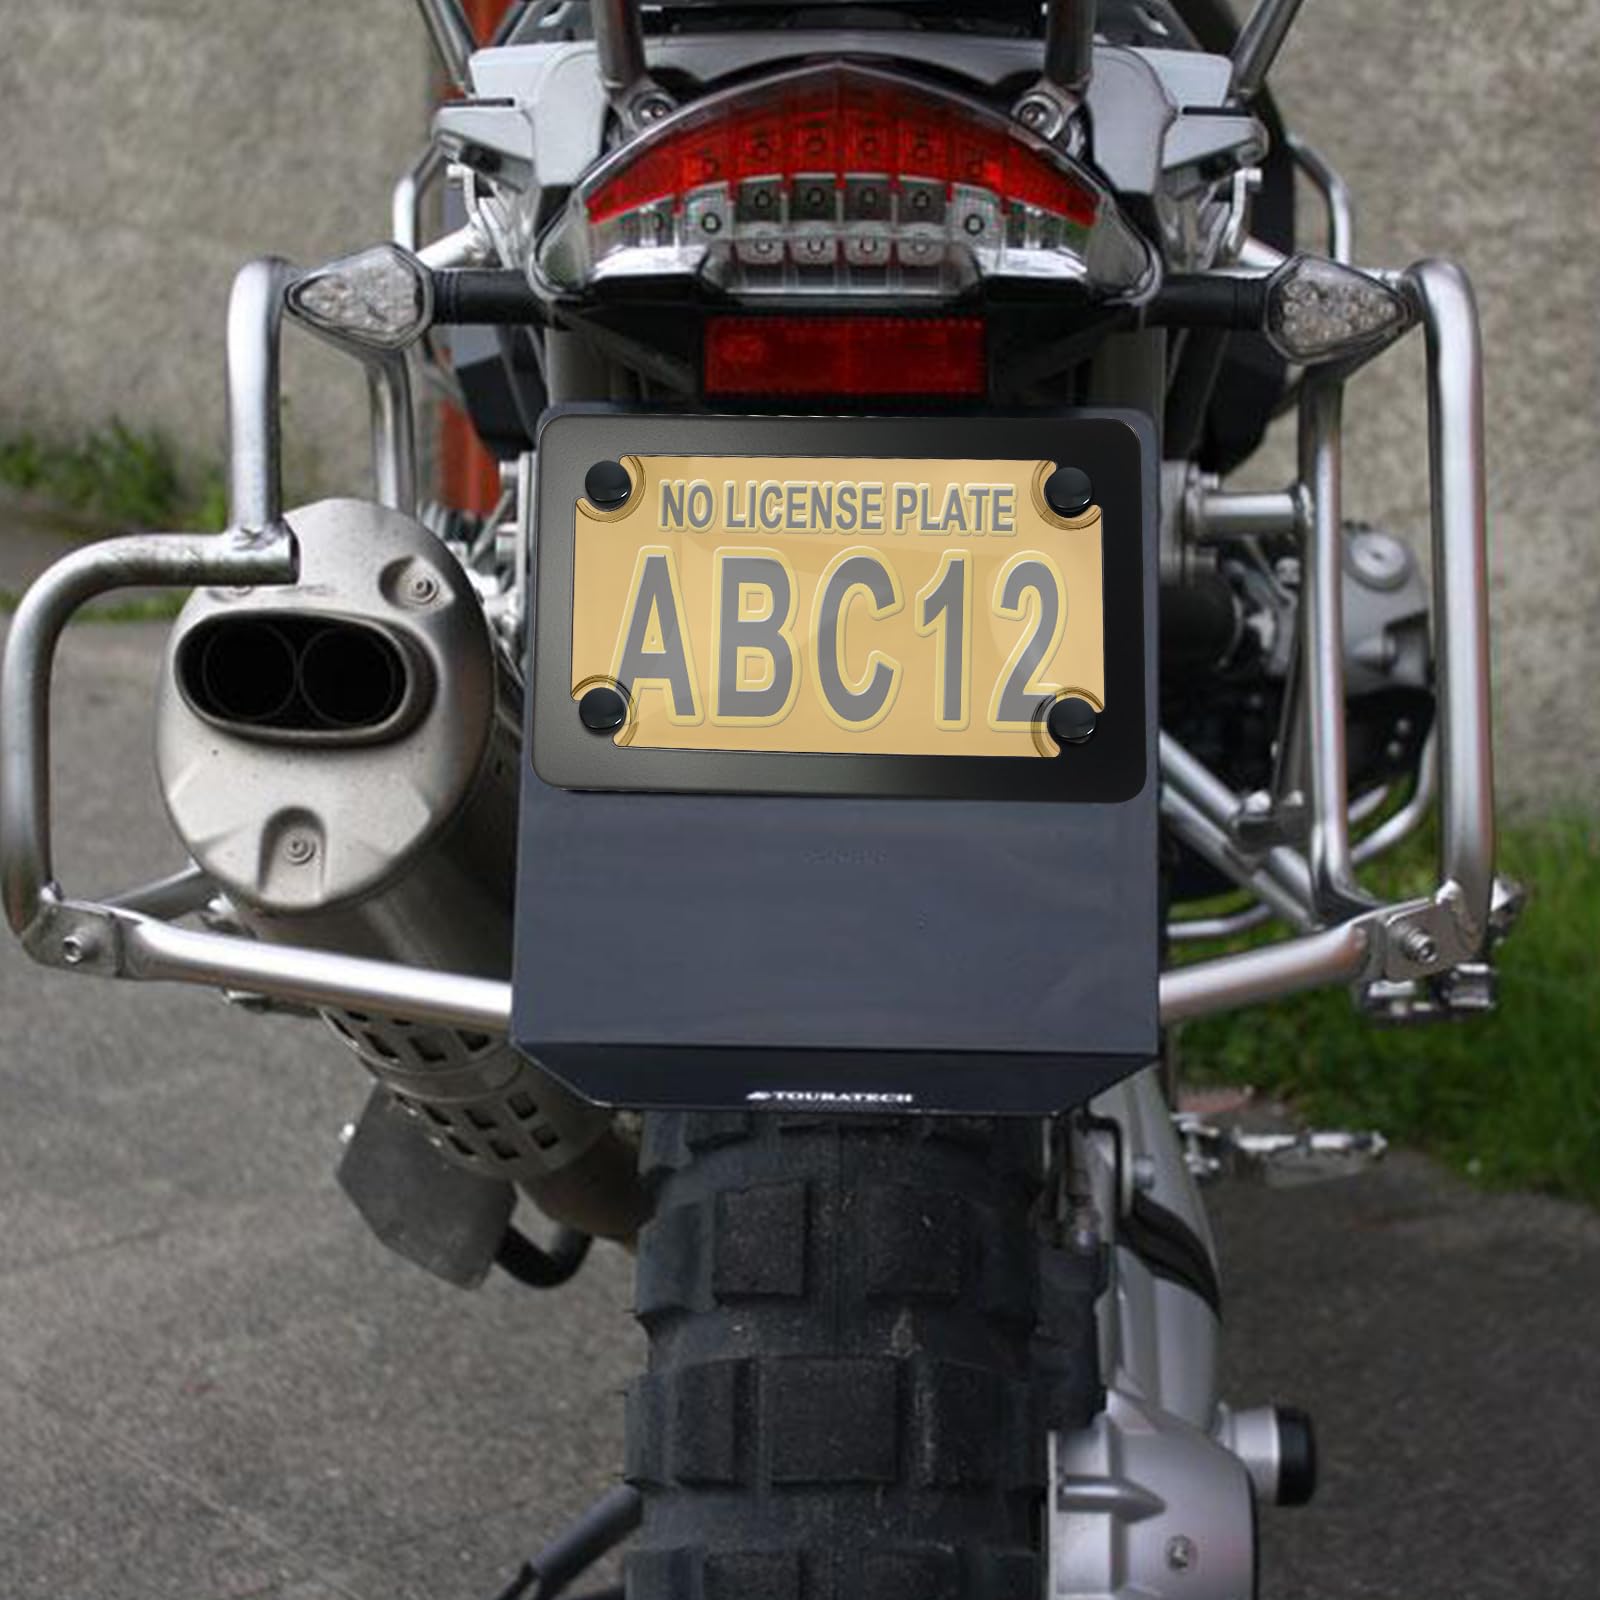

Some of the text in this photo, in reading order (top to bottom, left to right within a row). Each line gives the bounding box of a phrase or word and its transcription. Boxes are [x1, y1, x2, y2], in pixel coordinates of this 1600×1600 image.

[659, 480, 1017, 534] NO LICENSE PLATE
[612, 547, 1068, 732] ABC12
[772, 1091, 912, 1103] TOURATECH
